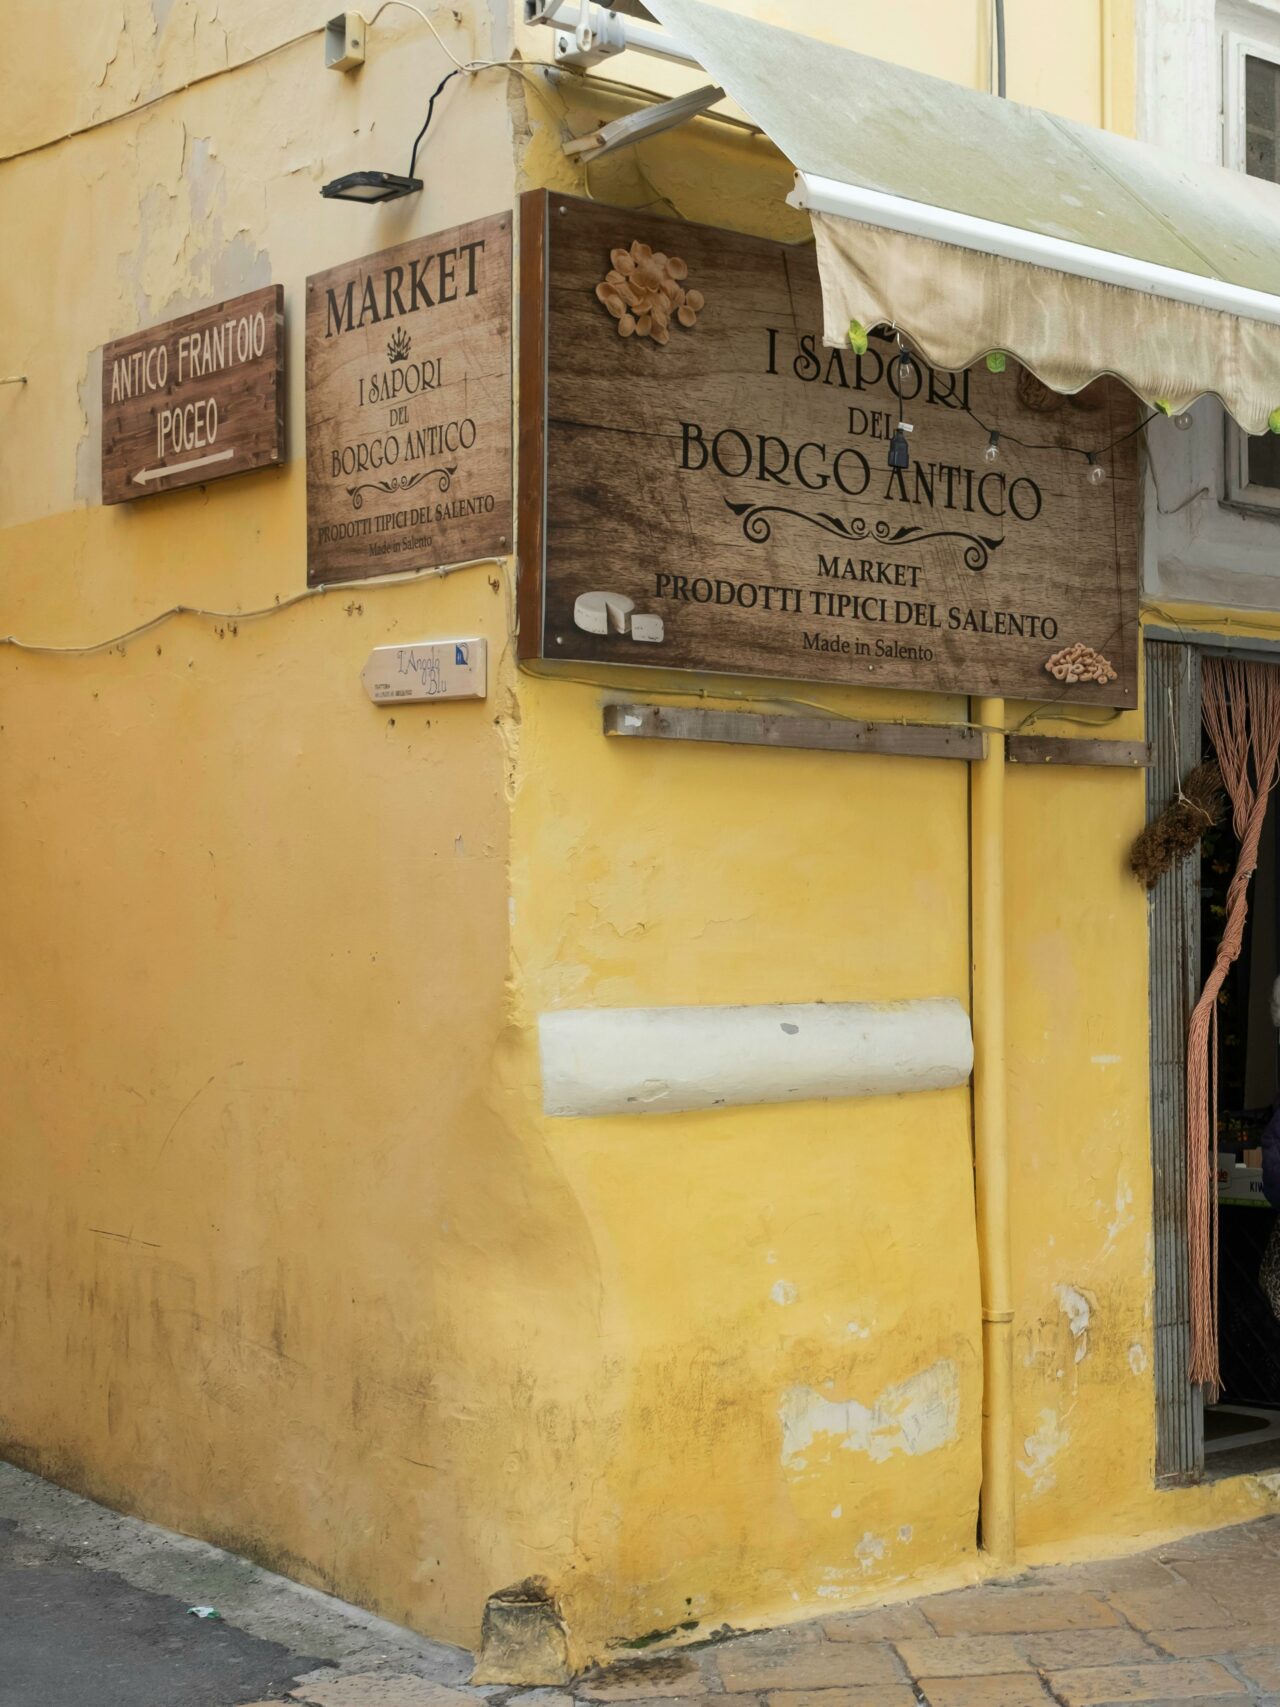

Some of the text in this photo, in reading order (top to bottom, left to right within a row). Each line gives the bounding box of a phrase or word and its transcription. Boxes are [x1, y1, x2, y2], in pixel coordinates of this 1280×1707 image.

[325, 240, 485, 339] MARKET
[111, 312, 265, 404] ANTICO FRANTOIO
[359, 357, 442, 407] I SAPORI
[766, 328, 972, 412] I SAPORI
[157, 397, 218, 459] IPOGEO
[389, 405, 410, 427] DEL
[847, 406, 897, 441] DEL
[332, 418, 476, 478] BORGO ANTICO
[678, 422, 1042, 521] BORGO ANTICO
[318, 494, 495, 547] PRODOTTI TIPICI DEL SALENTO
[368, 540, 392, 557] Made
[402, 534, 433, 551] Salento
[817, 553, 922, 588] MARKET
[654, 573, 1059, 640] PRODOTTI TIPICI DEL SALENTO
[802, 632, 934, 662] Made in Salento
